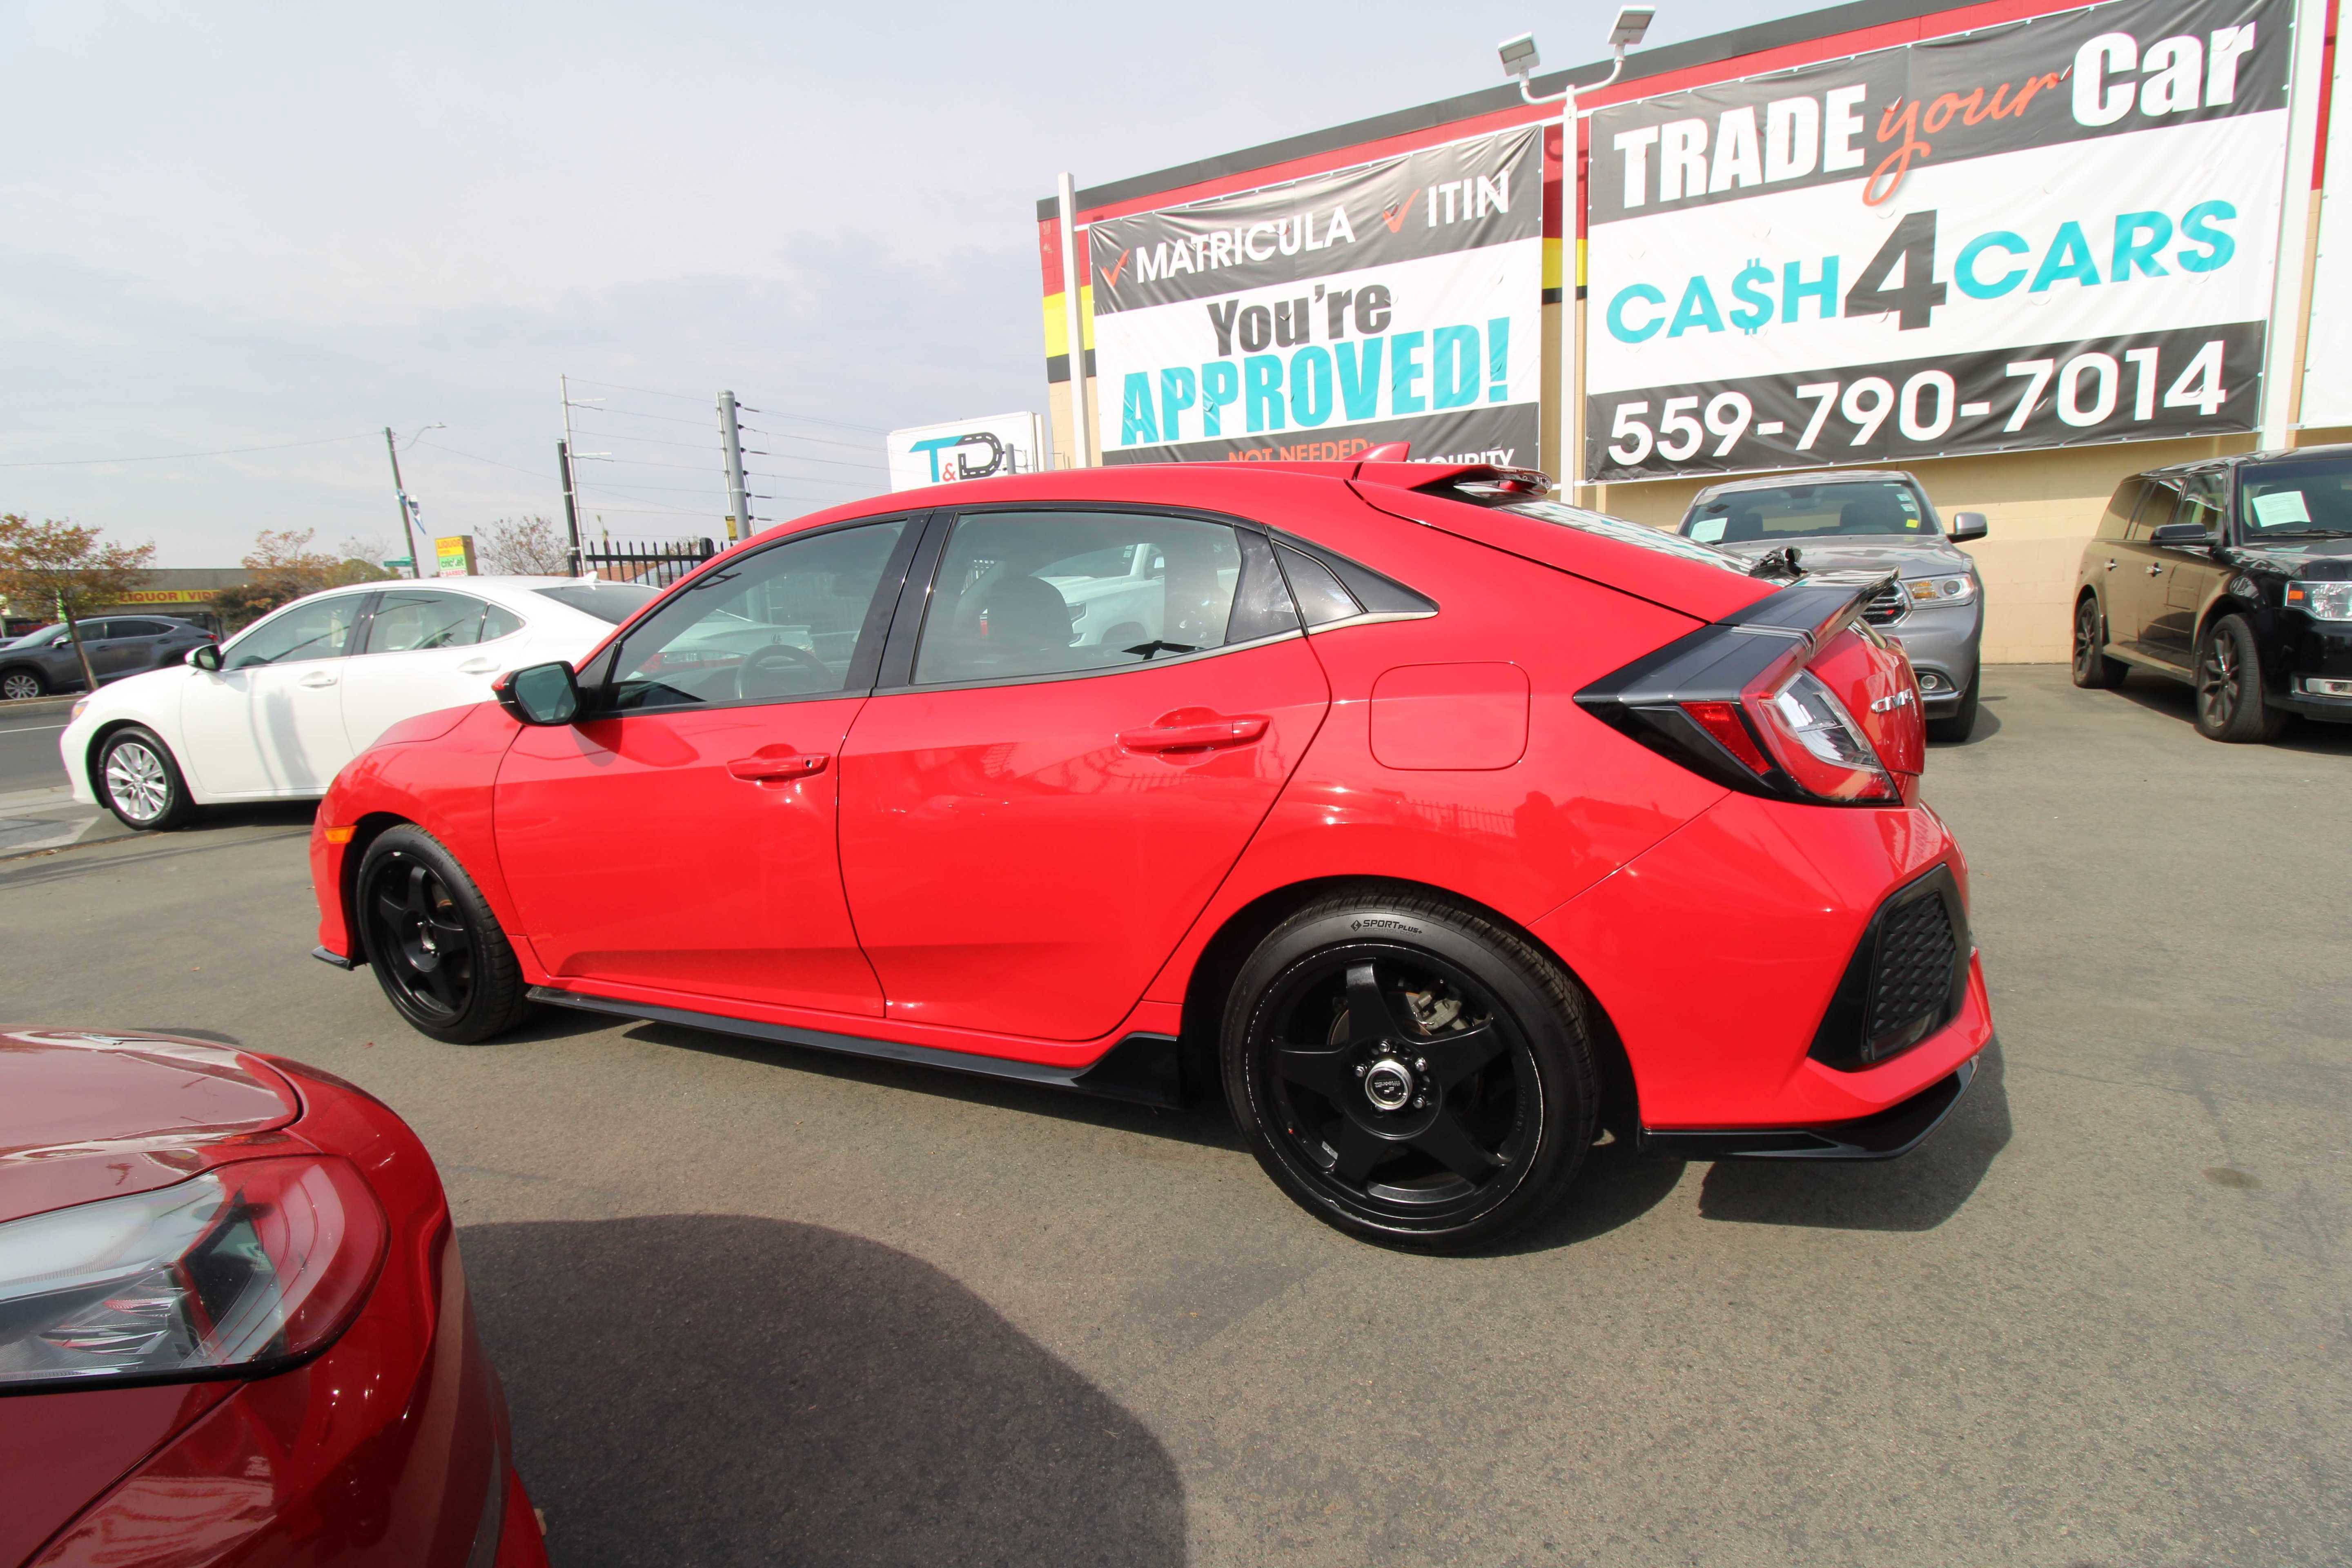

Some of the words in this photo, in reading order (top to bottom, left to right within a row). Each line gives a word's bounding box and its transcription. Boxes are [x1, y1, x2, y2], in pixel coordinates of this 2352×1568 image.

[1614, 83, 1866, 208] TRADE
[1862, 70, 2059, 206] your
[2071, 20, 2255, 127] Car
[1136, 206, 1356, 284] MATRICULA
[1428, 170, 1508, 228] ITIN
[1606, 255, 1839, 344] CA$H
[1953, 200, 2238, 300] CARS
[1121, 316, 1510, 446] APPROVED!
[1207, 284, 1392, 356] You're
[1608, 341, 2227, 466] 559-790-7014
[120, 592, 178, 602] LIQUOR
